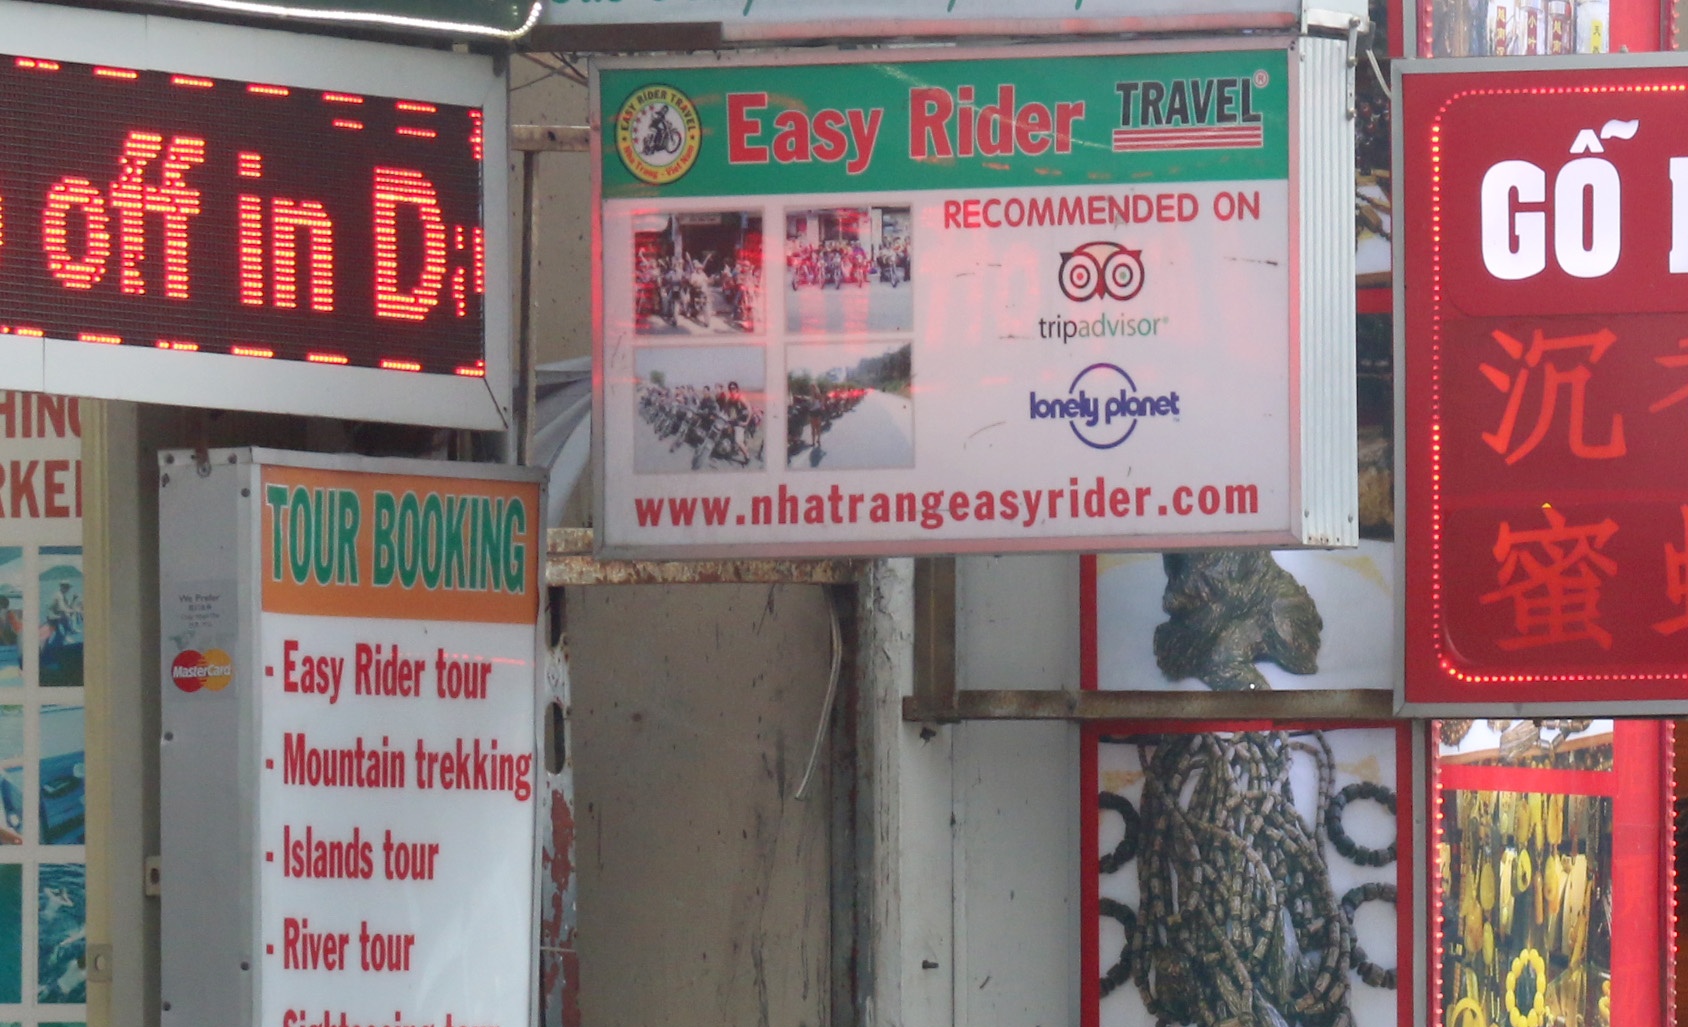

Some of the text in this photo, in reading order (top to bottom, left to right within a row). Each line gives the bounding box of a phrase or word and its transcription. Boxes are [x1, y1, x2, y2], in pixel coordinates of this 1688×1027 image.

[727, 85, 1085, 174] Easy Rider
[1116, 78, 1262, 126] TRAVEL
[43, 132, 205, 299] off
[239, 152, 334, 312] in
[944, 192, 1260, 229] RECOMMENDED ON
[1480, 119, 1640, 281] GỖ
[1038, 313, 1161, 344] tripadvisor
[1030, 389, 1180, 427] lonely planet
[635, 477, 1259, 529] www.nhatrangeasyrider.com
[265, 483, 526, 595] TOUR BOOKING
[173, 663, 231, 678] MasterCard
[284, 640, 492, 703] Easy Rider tour
[283, 733, 533, 801] Mountain trekking
[283, 825, 439, 881] Islands tour
[283, 917, 415, 971] River tour
